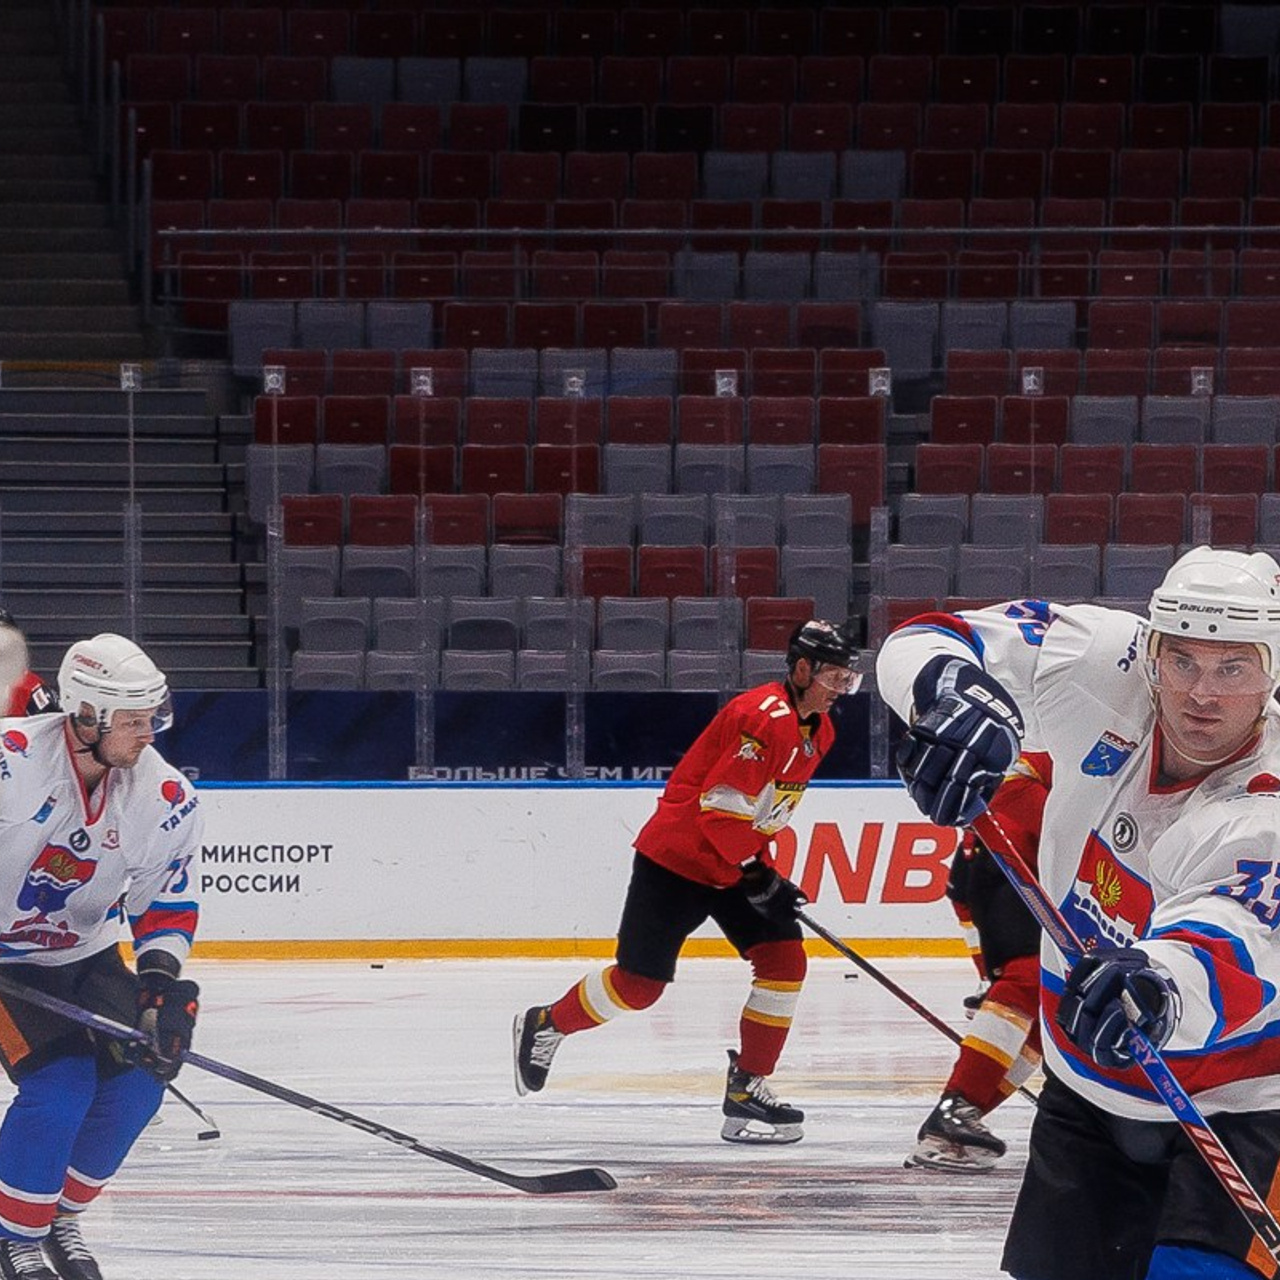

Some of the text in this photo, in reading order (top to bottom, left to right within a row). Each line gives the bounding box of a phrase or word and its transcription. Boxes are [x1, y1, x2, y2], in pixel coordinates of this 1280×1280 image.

[1178, 602, 1225, 615] BAUER
[758, 694, 792, 719] 17
[407, 765, 549, 782] БОЛЬШЕ
[201, 844, 333, 864] МИНСПОРТ
[201, 874, 300, 893] РОССИИ
